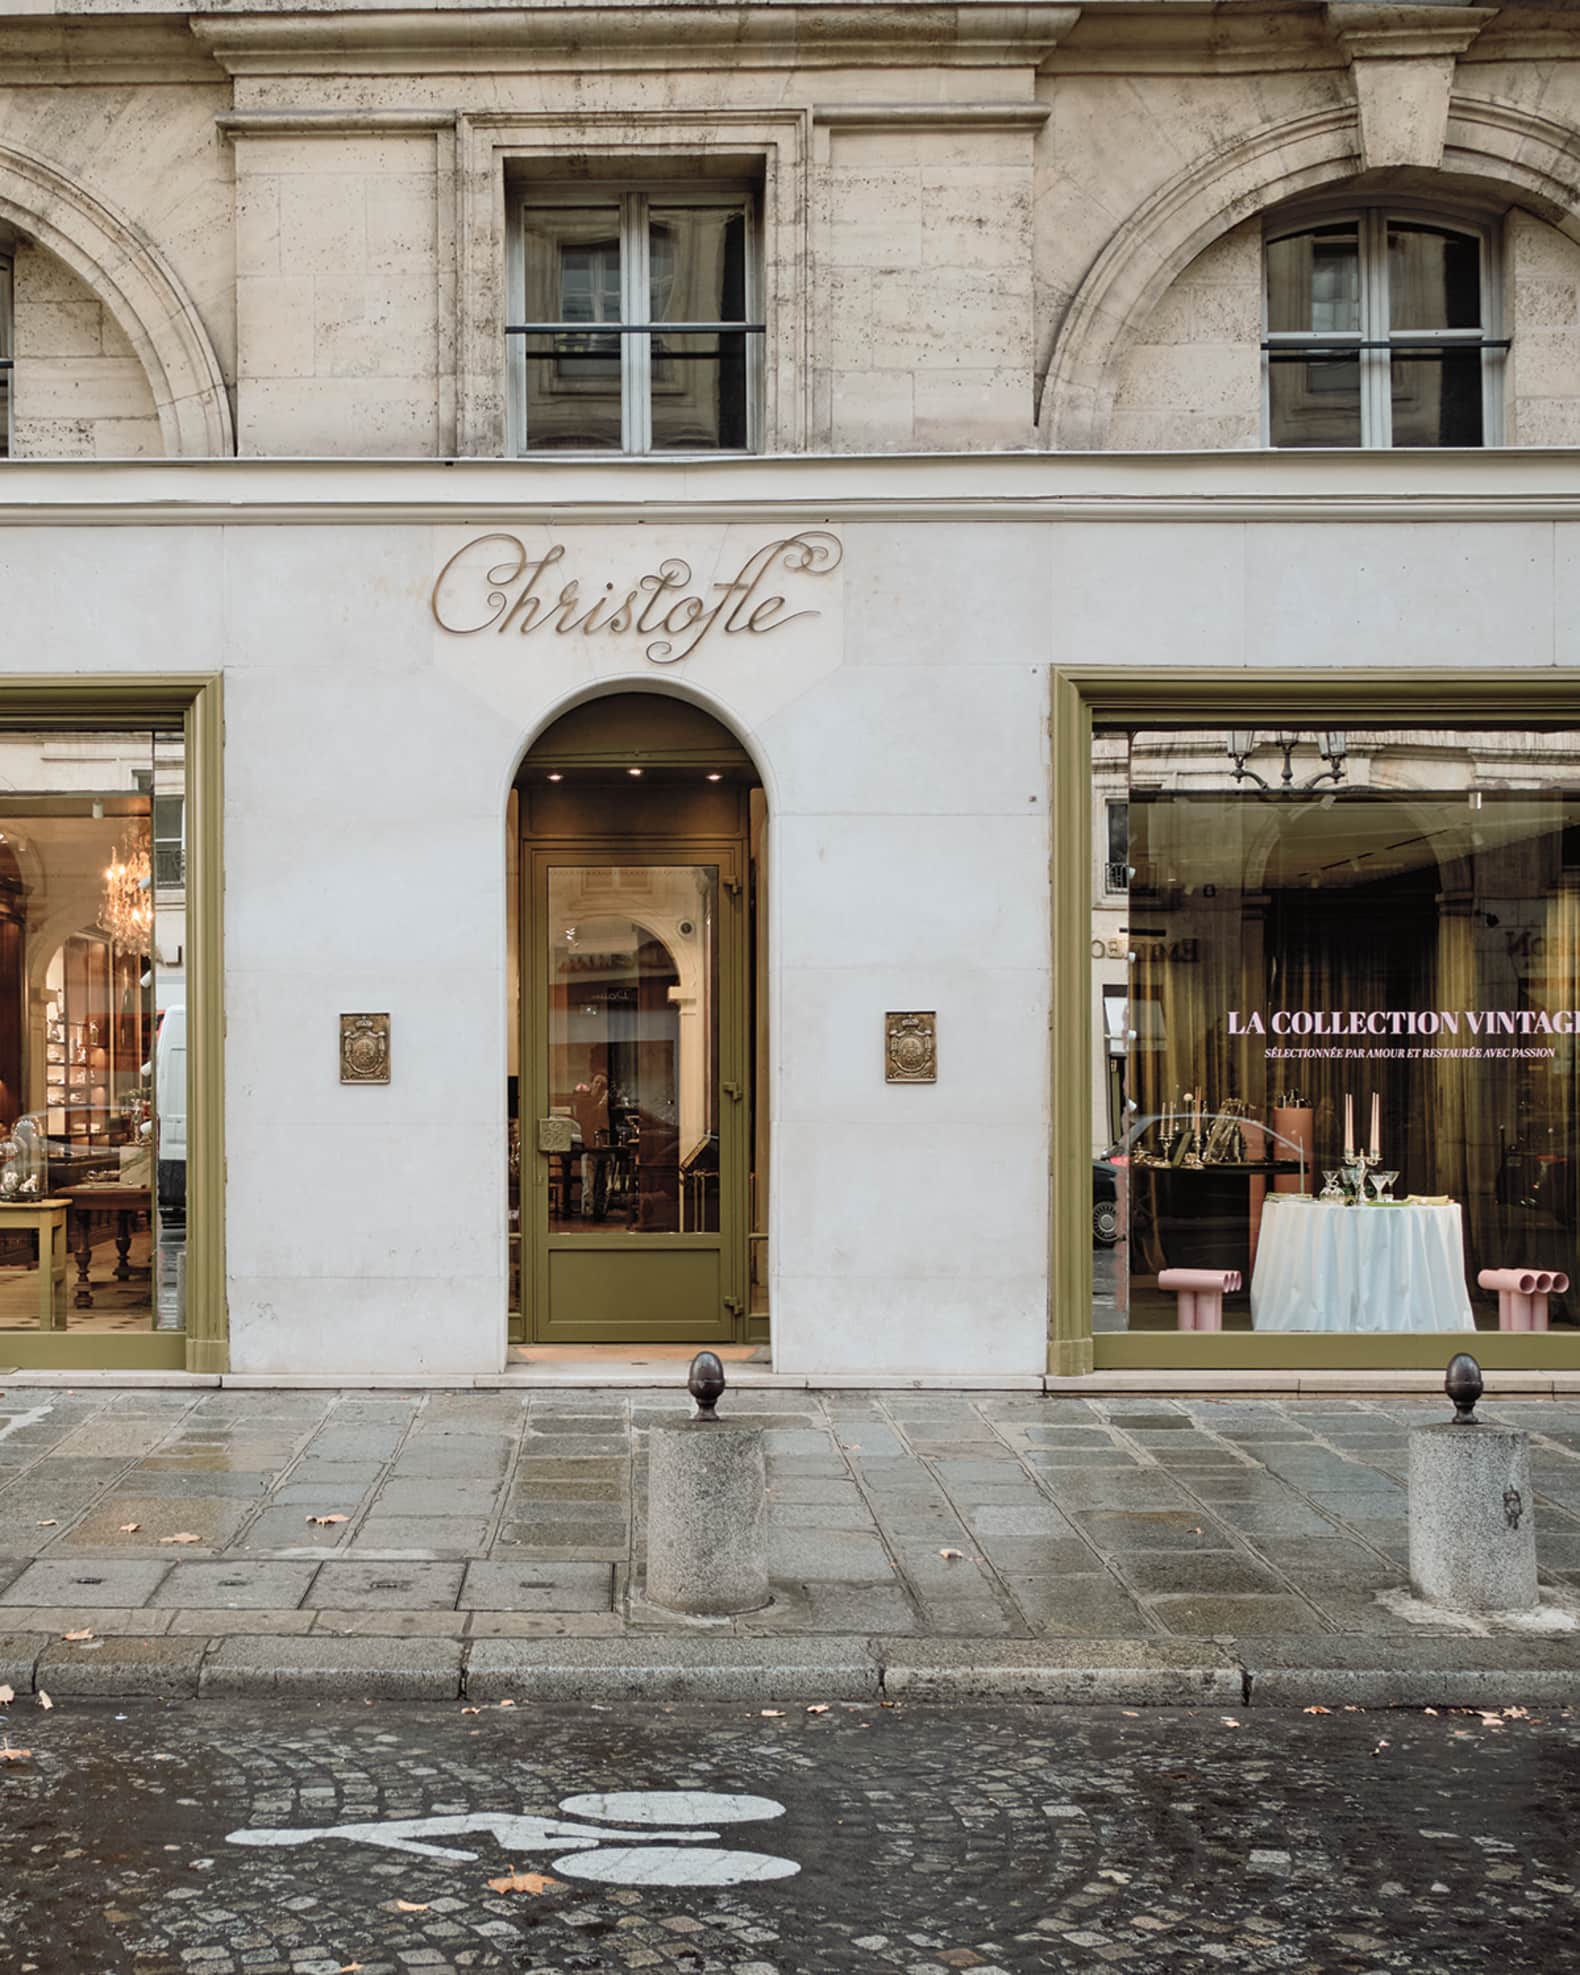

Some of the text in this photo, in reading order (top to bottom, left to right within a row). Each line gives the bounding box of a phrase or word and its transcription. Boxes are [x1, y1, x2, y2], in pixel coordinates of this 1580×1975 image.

[432, 530, 843, 665] Christofle
[1227, 1011, 1266, 1035] LA
[1271, 1011, 1460, 1035] COLLECTION
[1264, 1046, 1556, 1058] SÉLECTIONNÉE PAR AMOUR ET RESTAURÉE AVEC PASSION
